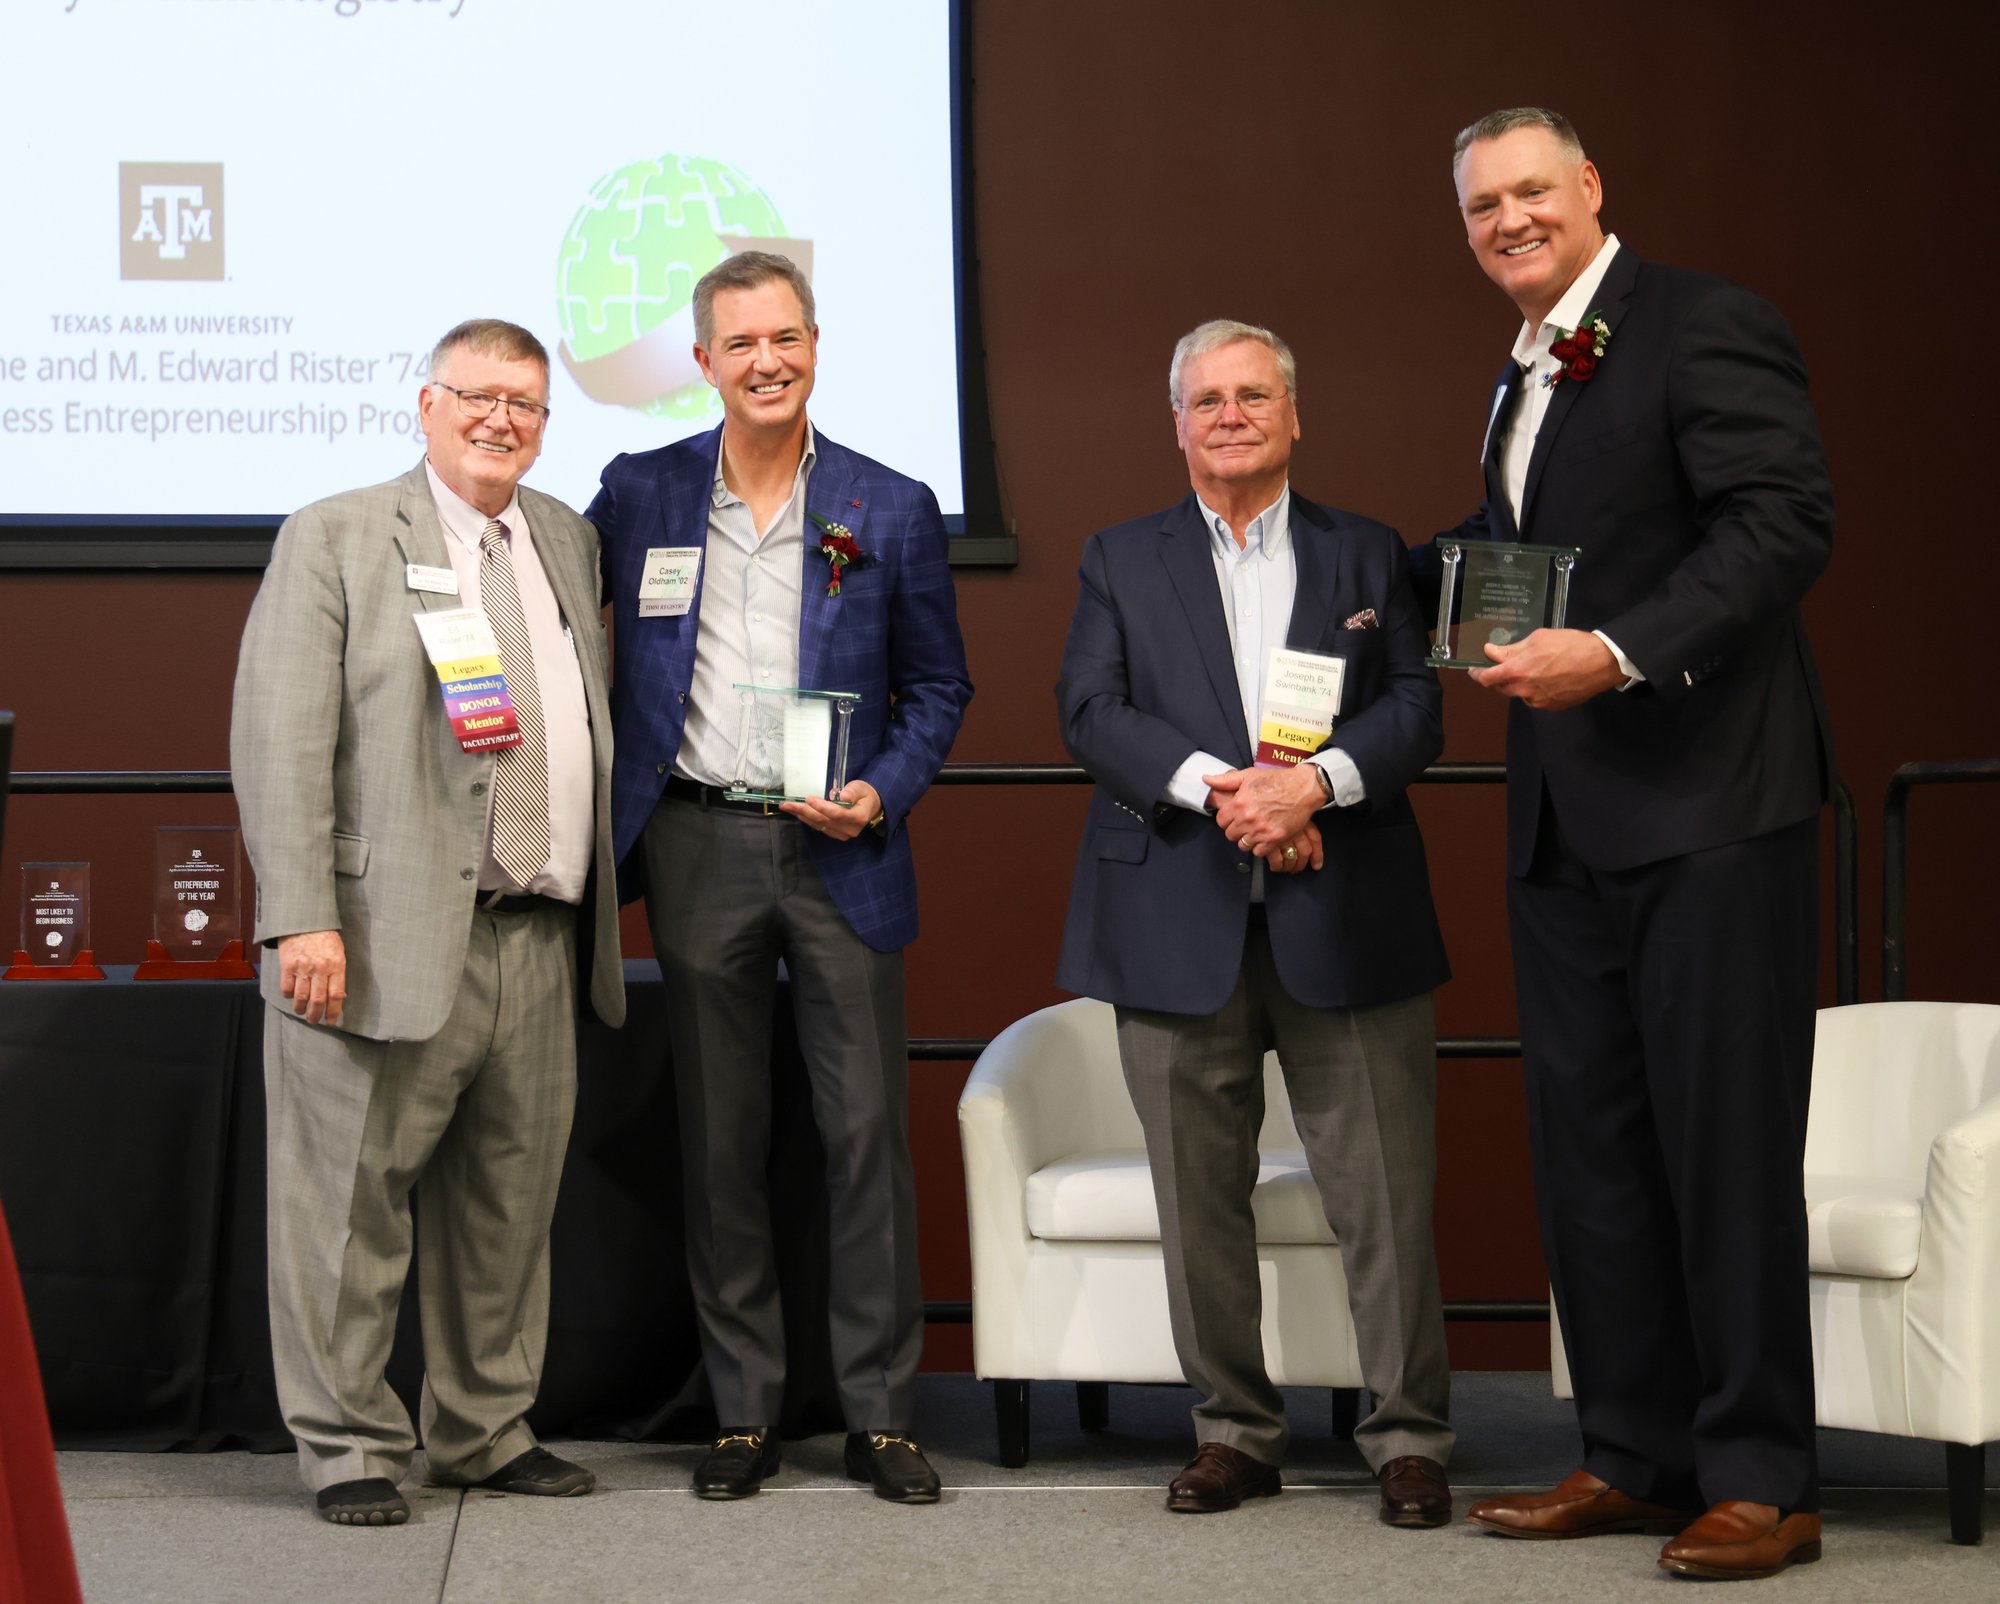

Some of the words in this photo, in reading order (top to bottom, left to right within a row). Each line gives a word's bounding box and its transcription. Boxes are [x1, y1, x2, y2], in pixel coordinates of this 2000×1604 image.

[51, 315, 112, 334] TEXAS
[119, 315, 167, 334] A&M
[174, 315, 294, 335] UNIVERSITY
[37, 349, 97, 382] and
[109, 350, 147, 382] M.
[158, 349, 278, 383] Edward
[289, 351, 380, 383] Rister
[2, 407, 54, 434] ess
[65, 401, 348, 443] Entrepreneurship
[659, 567, 682, 576] Casey
[648, 577, 676, 585] Oldham
[678, 576, 689, 585] '02
[452, 664, 485, 675] Legacy
[1283, 669, 1315, 683] Joseph
[1317, 675, 1326, 685] B.
[446, 680, 503, 694] Scholarship
[1275, 679, 1317, 695] Swinbank
[1319, 687, 1332, 697] '74
[458, 696, 502, 713] DONOR
[463, 715, 505, 731] Mentor
[1291, 715, 1324, 727] REGISTRY
[462, 733, 520, 749] FACULTY/STAFF
[1277, 728, 1313, 745] Legacy
[174, 880, 220, 889] ENTREPRENEUR
[178, 892, 186, 901] OF
[187, 892, 198, 901] THE
[199, 892, 215, 901] YEAR
